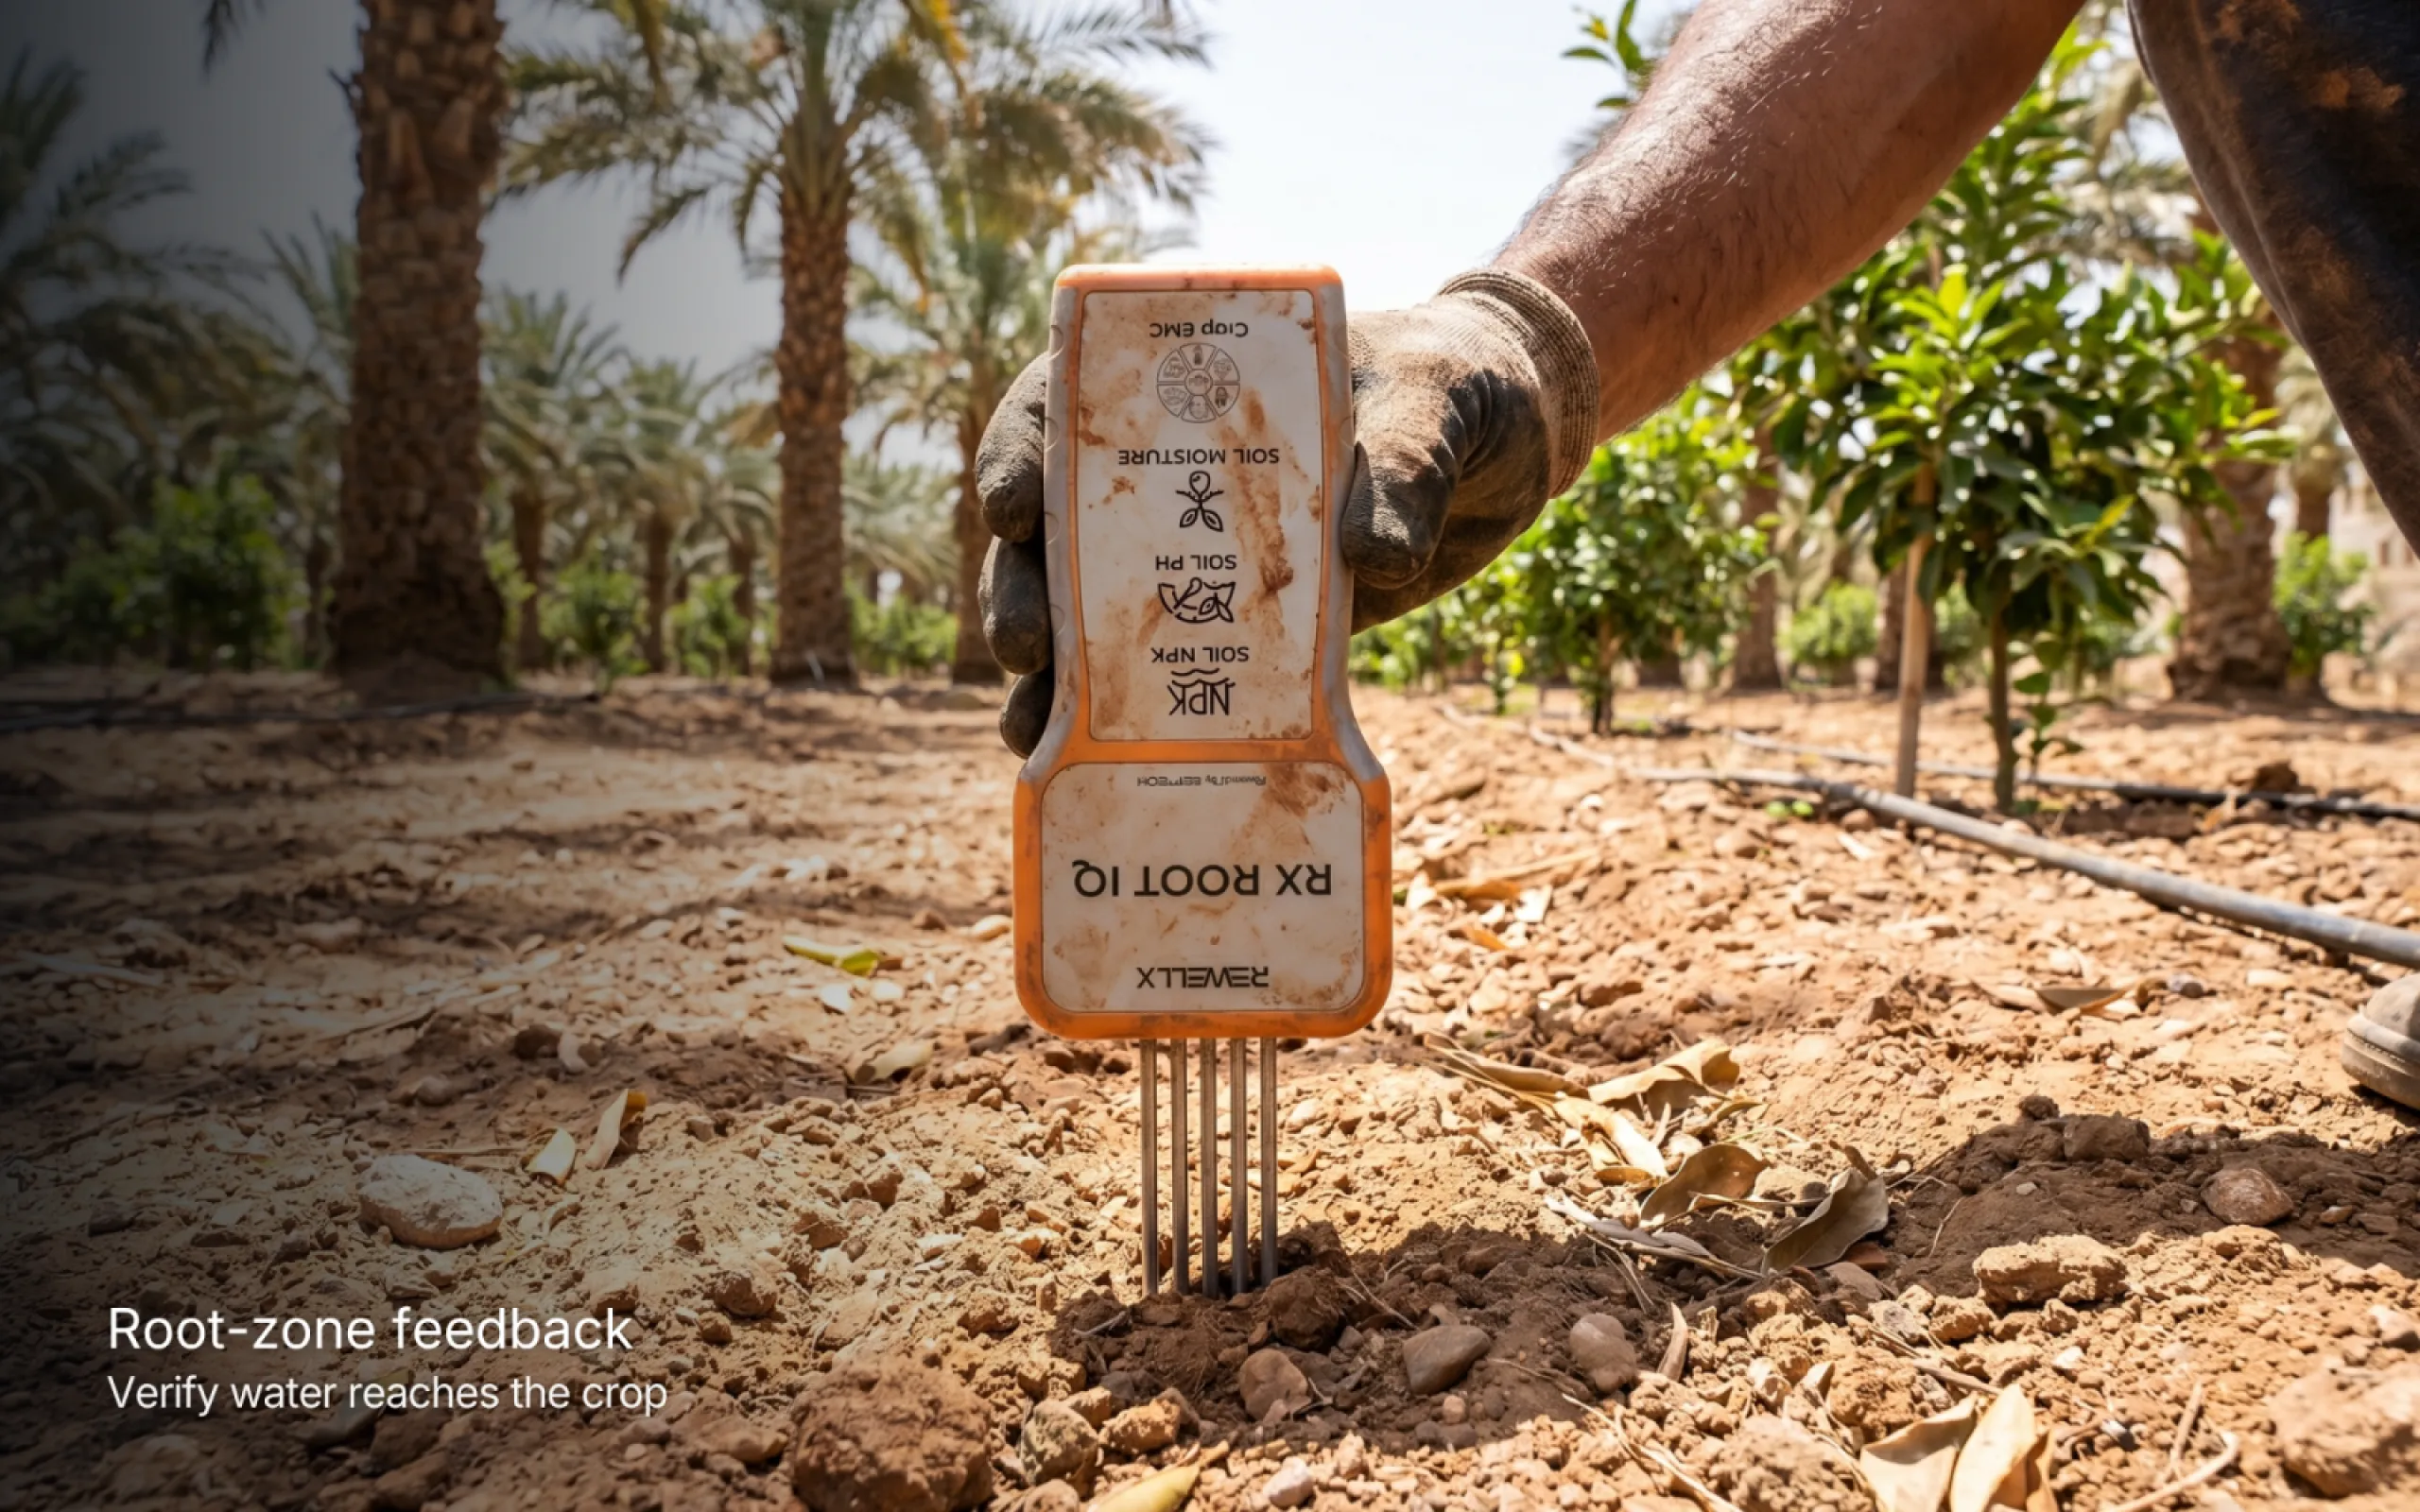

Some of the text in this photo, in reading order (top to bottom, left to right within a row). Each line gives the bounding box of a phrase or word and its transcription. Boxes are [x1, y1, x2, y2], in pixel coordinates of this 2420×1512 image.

[1149, 321, 1196, 338] EMC
[1117, 448, 1280, 465] SOIL MOISTURE
[1154, 554, 1237, 571] SOIL PH
[1150, 645, 1250, 662] SOIL NPK
[1167, 680, 1232, 716] NPK
[1071, 859, 1332, 898] RX ROOT IQ
[1136, 966, 1270, 989] REWELLX
